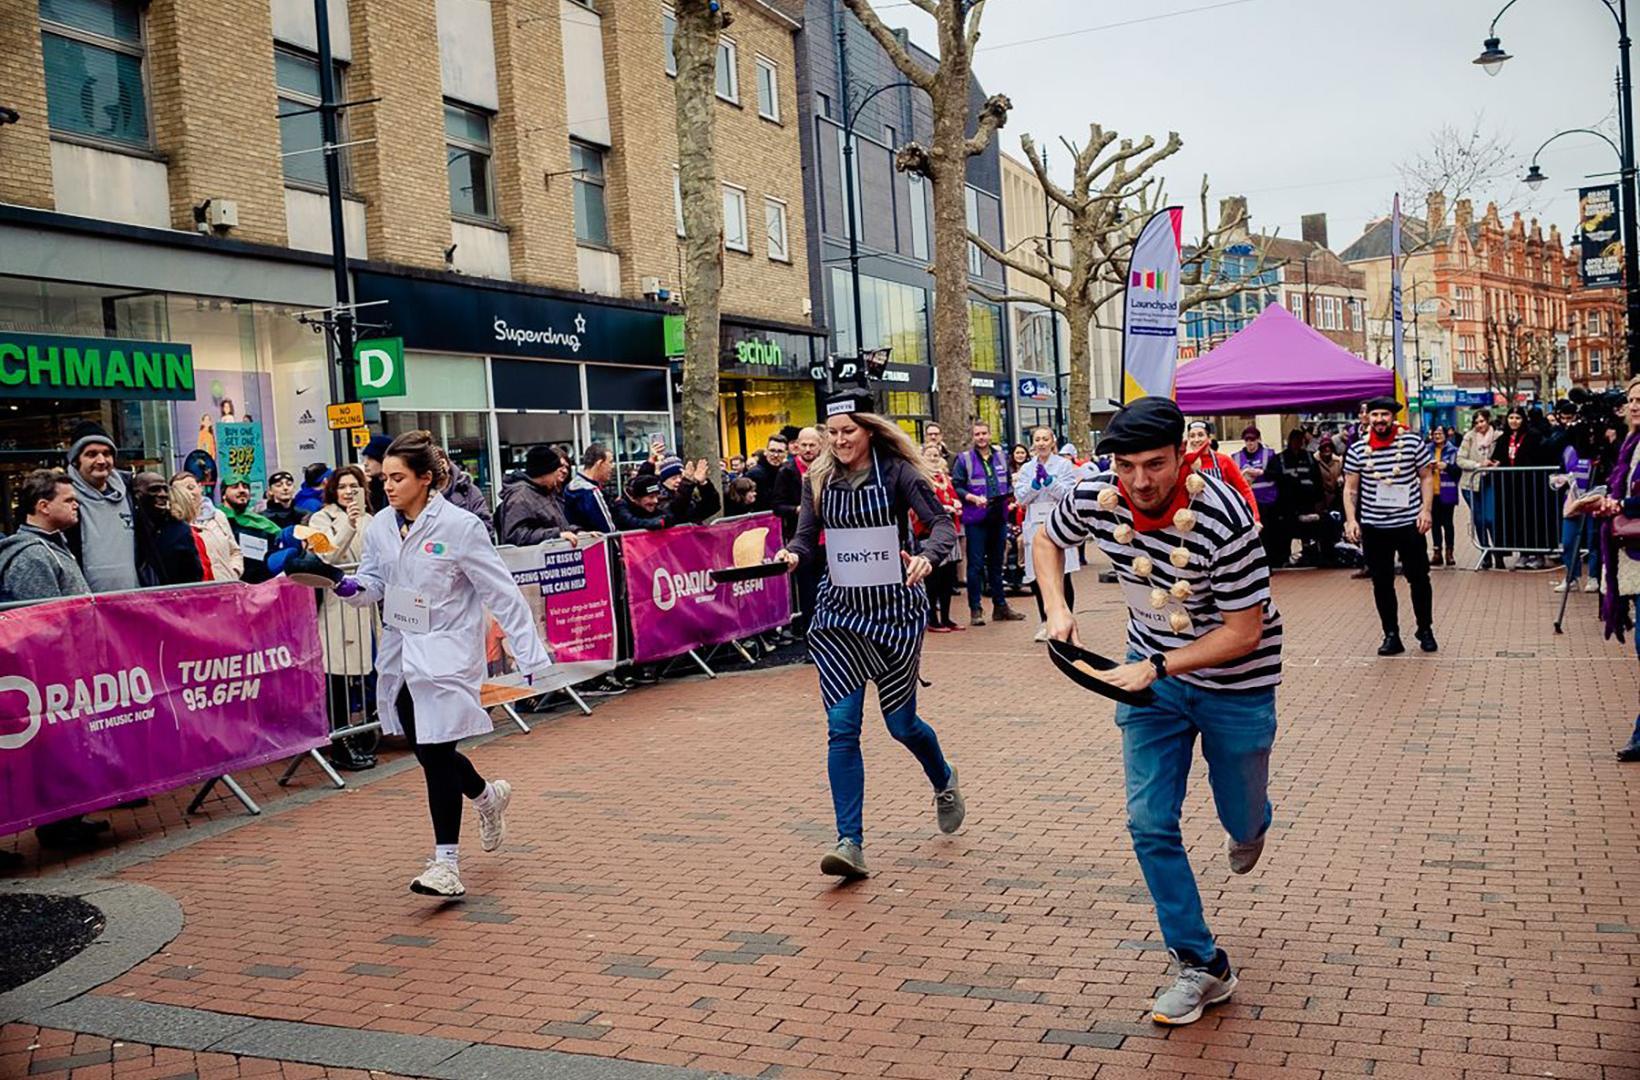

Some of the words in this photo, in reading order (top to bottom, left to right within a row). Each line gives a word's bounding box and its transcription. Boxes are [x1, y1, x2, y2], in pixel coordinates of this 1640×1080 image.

[1131, 298, 1177, 312] Launchpad
[494, 317, 582, 352] Superdrug
[735, 339, 782, 366] schuh
[0, 343, 194, 390] CHMANN
[360, 349, 394, 388] D
[331, 416, 362, 427] YCLING
[340, 406, 351, 415] NO
[546, 555, 555, 565] AT
[556, 553, 573, 563] RISK
[574, 551, 582, 561] OF
[837, 549, 889, 563] EGNYTE
[512, 571, 539, 583] OSING
[540, 568, 560, 579] YOUR
[560, 565, 585, 577] HOME?
[541, 583, 554, 595] WE
[554, 581, 571, 592] CAN
[571, 578, 586, 590] HELP
[673, 568, 717, 597] RADIO
[732, 577, 764, 597] 95.6FM
[178, 654, 243, 684] TUNE
[246, 652, 266, 674] IN
[266, 645, 292, 669] TO
[45, 666, 154, 724] RADIO
[182, 677, 260, 711] 95.6FM
[89, 719, 105, 732] HIT
[105, 712, 134, 728] MUSIC
[134, 707, 155, 721] NOW
